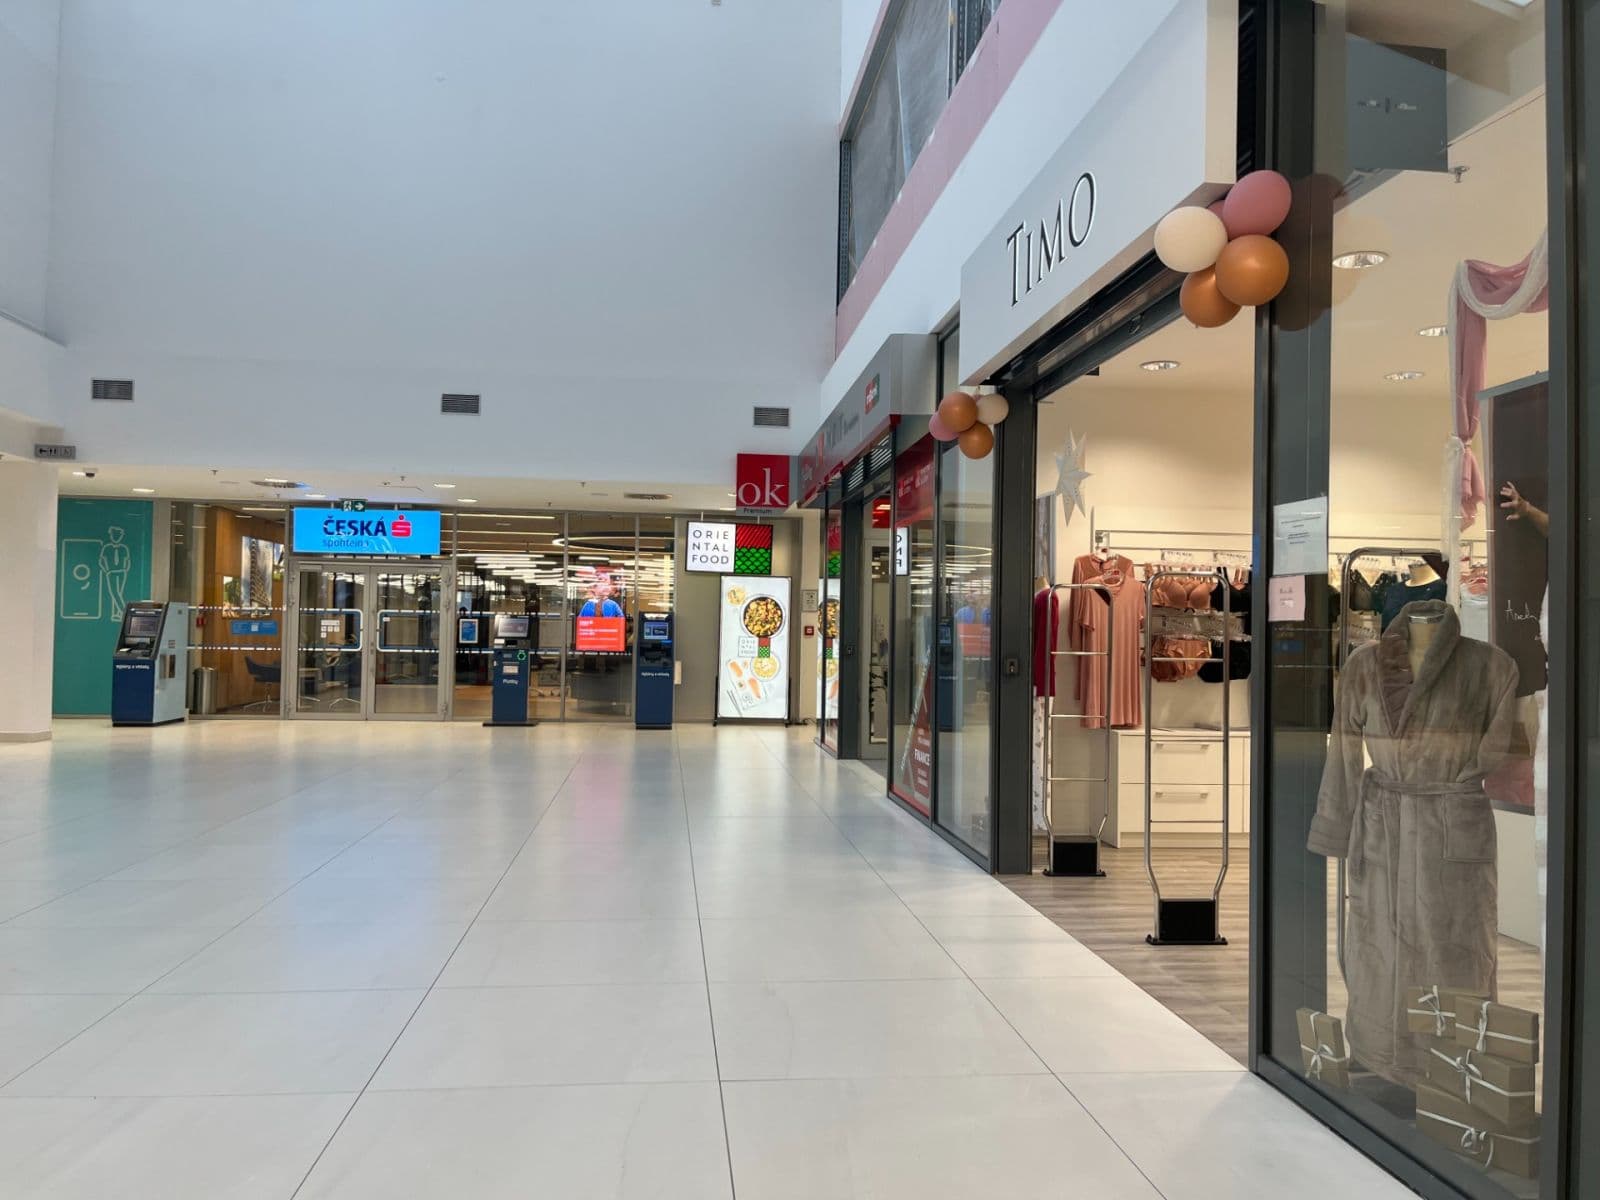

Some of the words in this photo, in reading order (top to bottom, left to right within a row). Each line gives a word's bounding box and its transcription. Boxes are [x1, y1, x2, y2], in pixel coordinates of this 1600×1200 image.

[1006, 172, 1096, 306] TIMO
[738, 468, 787, 505] ok
[323, 514, 387, 537] ČESKÁ
[693, 529, 729, 540] ORIE
[692, 541, 729, 553] NTAL
[692, 554, 729, 565] FOOD
